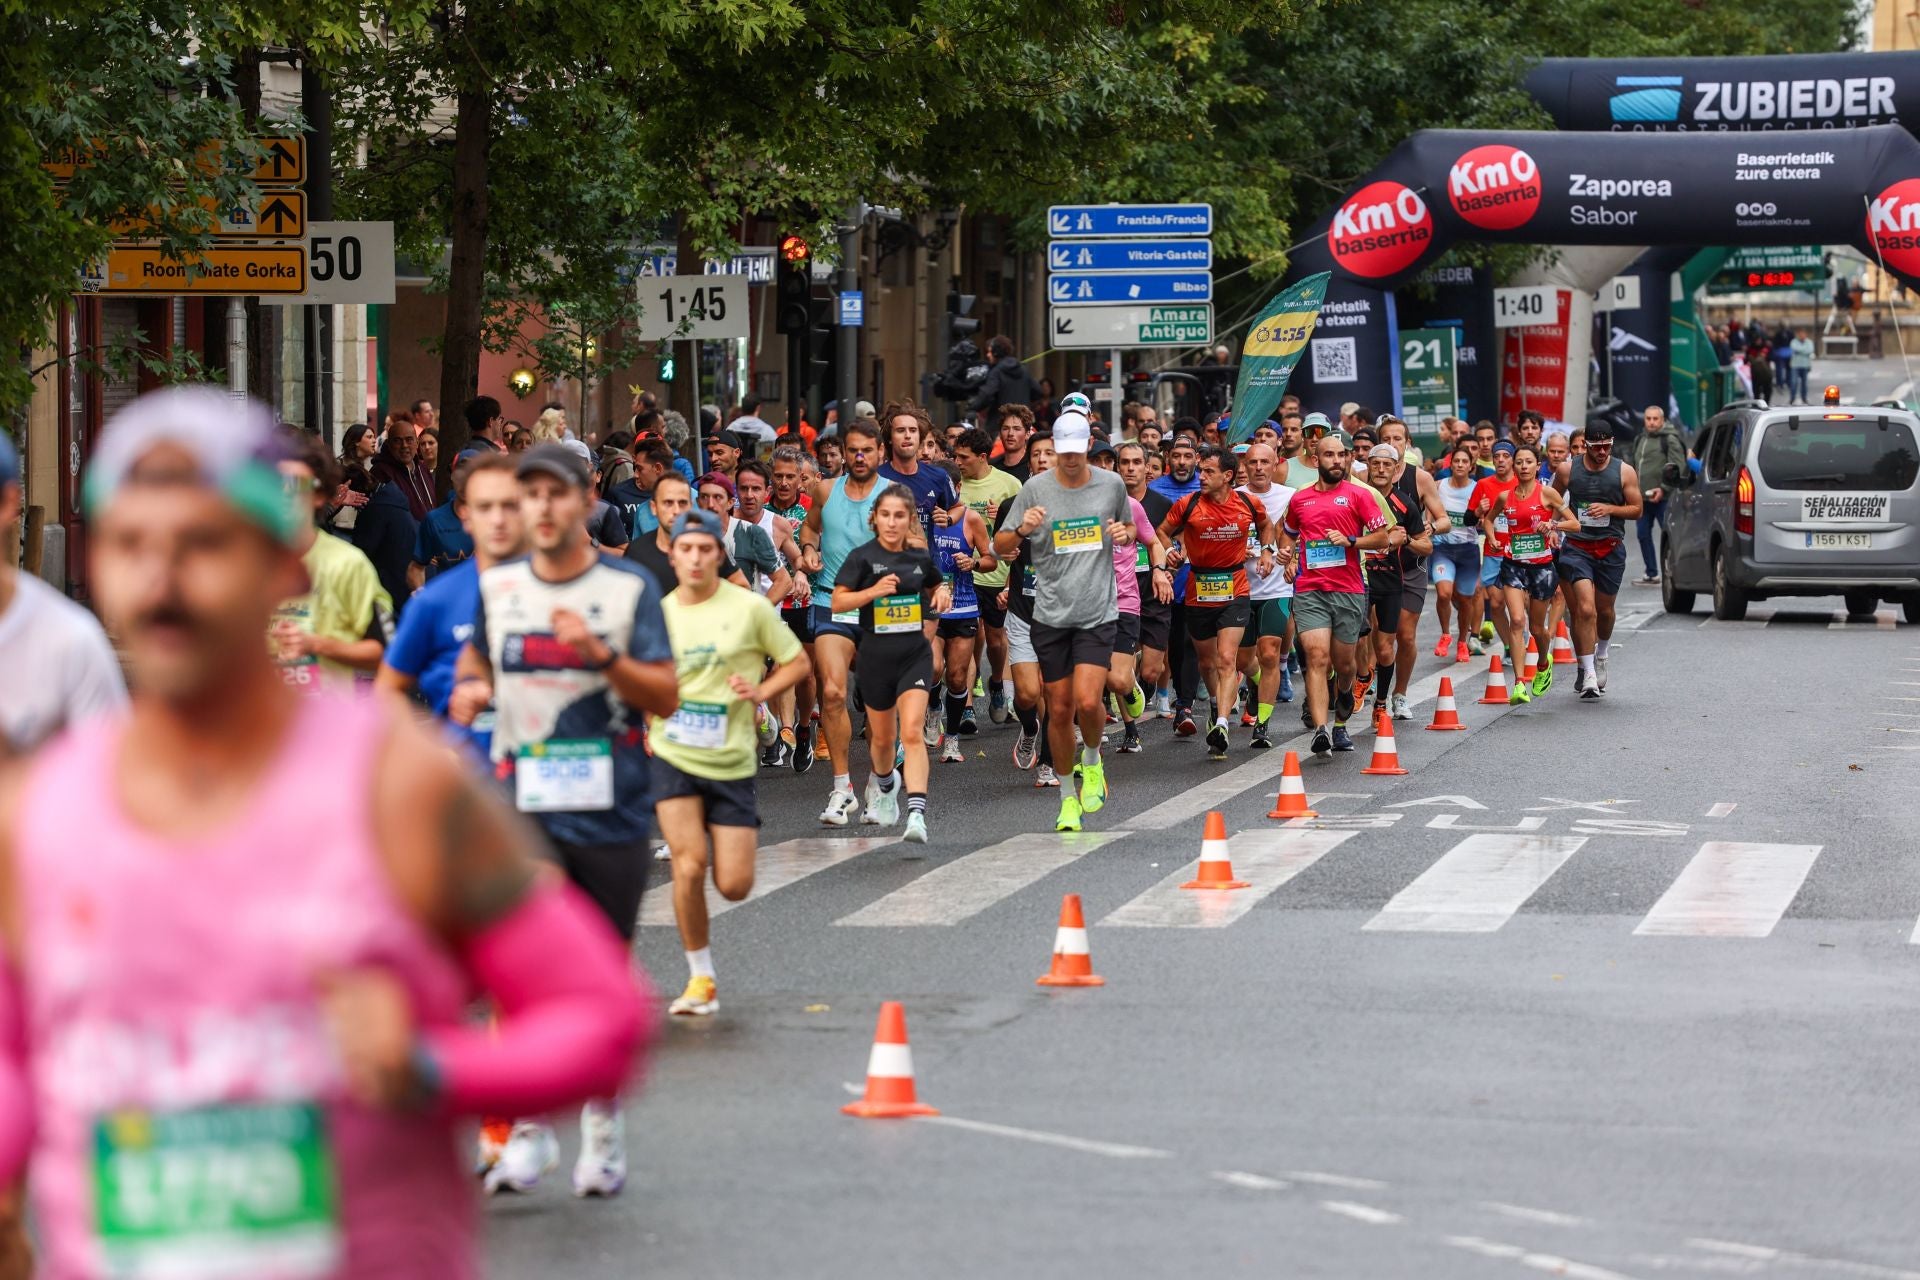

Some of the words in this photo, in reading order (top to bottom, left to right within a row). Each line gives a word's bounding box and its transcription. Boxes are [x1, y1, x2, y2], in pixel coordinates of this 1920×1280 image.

[1693, 76, 1897, 121] ZUBIEDER
[1736, 151, 1835, 166] Baserrietatik
[1450, 160, 1509, 197] Km
[1735, 168, 1769, 181] zure
[1772, 166, 1820, 180] etxera
[1569, 174, 1672, 201] Zaporea
[1456, 183, 1538, 214] baserria
[1117, 214, 1207, 226] Frantzia/Francia
[1332, 202, 1396, 238] Km
[1570, 205, 1639, 226] Sabor
[1335, 225, 1430, 257] baserria
[310, 236, 361, 281] 50
[1128, 249, 1207, 261] Vitoria-Gasteiz
[245, 261, 297, 278] Gorka
[1173, 281, 1208, 293] Bilbao
[659, 286, 726, 323] 1:45
[1497, 293, 1543, 316] 1:40
[1152, 309, 1206, 321] Amara
[1325, 314, 1368, 326] etxera
[1141, 324, 1207, 341] Antiguo
[1804, 494, 1887, 508] SEÑALIZACIÓN
[1809, 507, 1824, 518] DE
[1827, 507, 1881, 518] CARRERA
[1059, 527, 1096, 541] 2995
[1815, 534, 1842, 545] 1561
[1846, 534, 1868, 545] KST
[1514, 539, 1541, 551] 2565
[1310, 547, 1339, 559] 3827
[1201, 582, 1228, 591] 3154
[886, 606, 911, 618] 413
